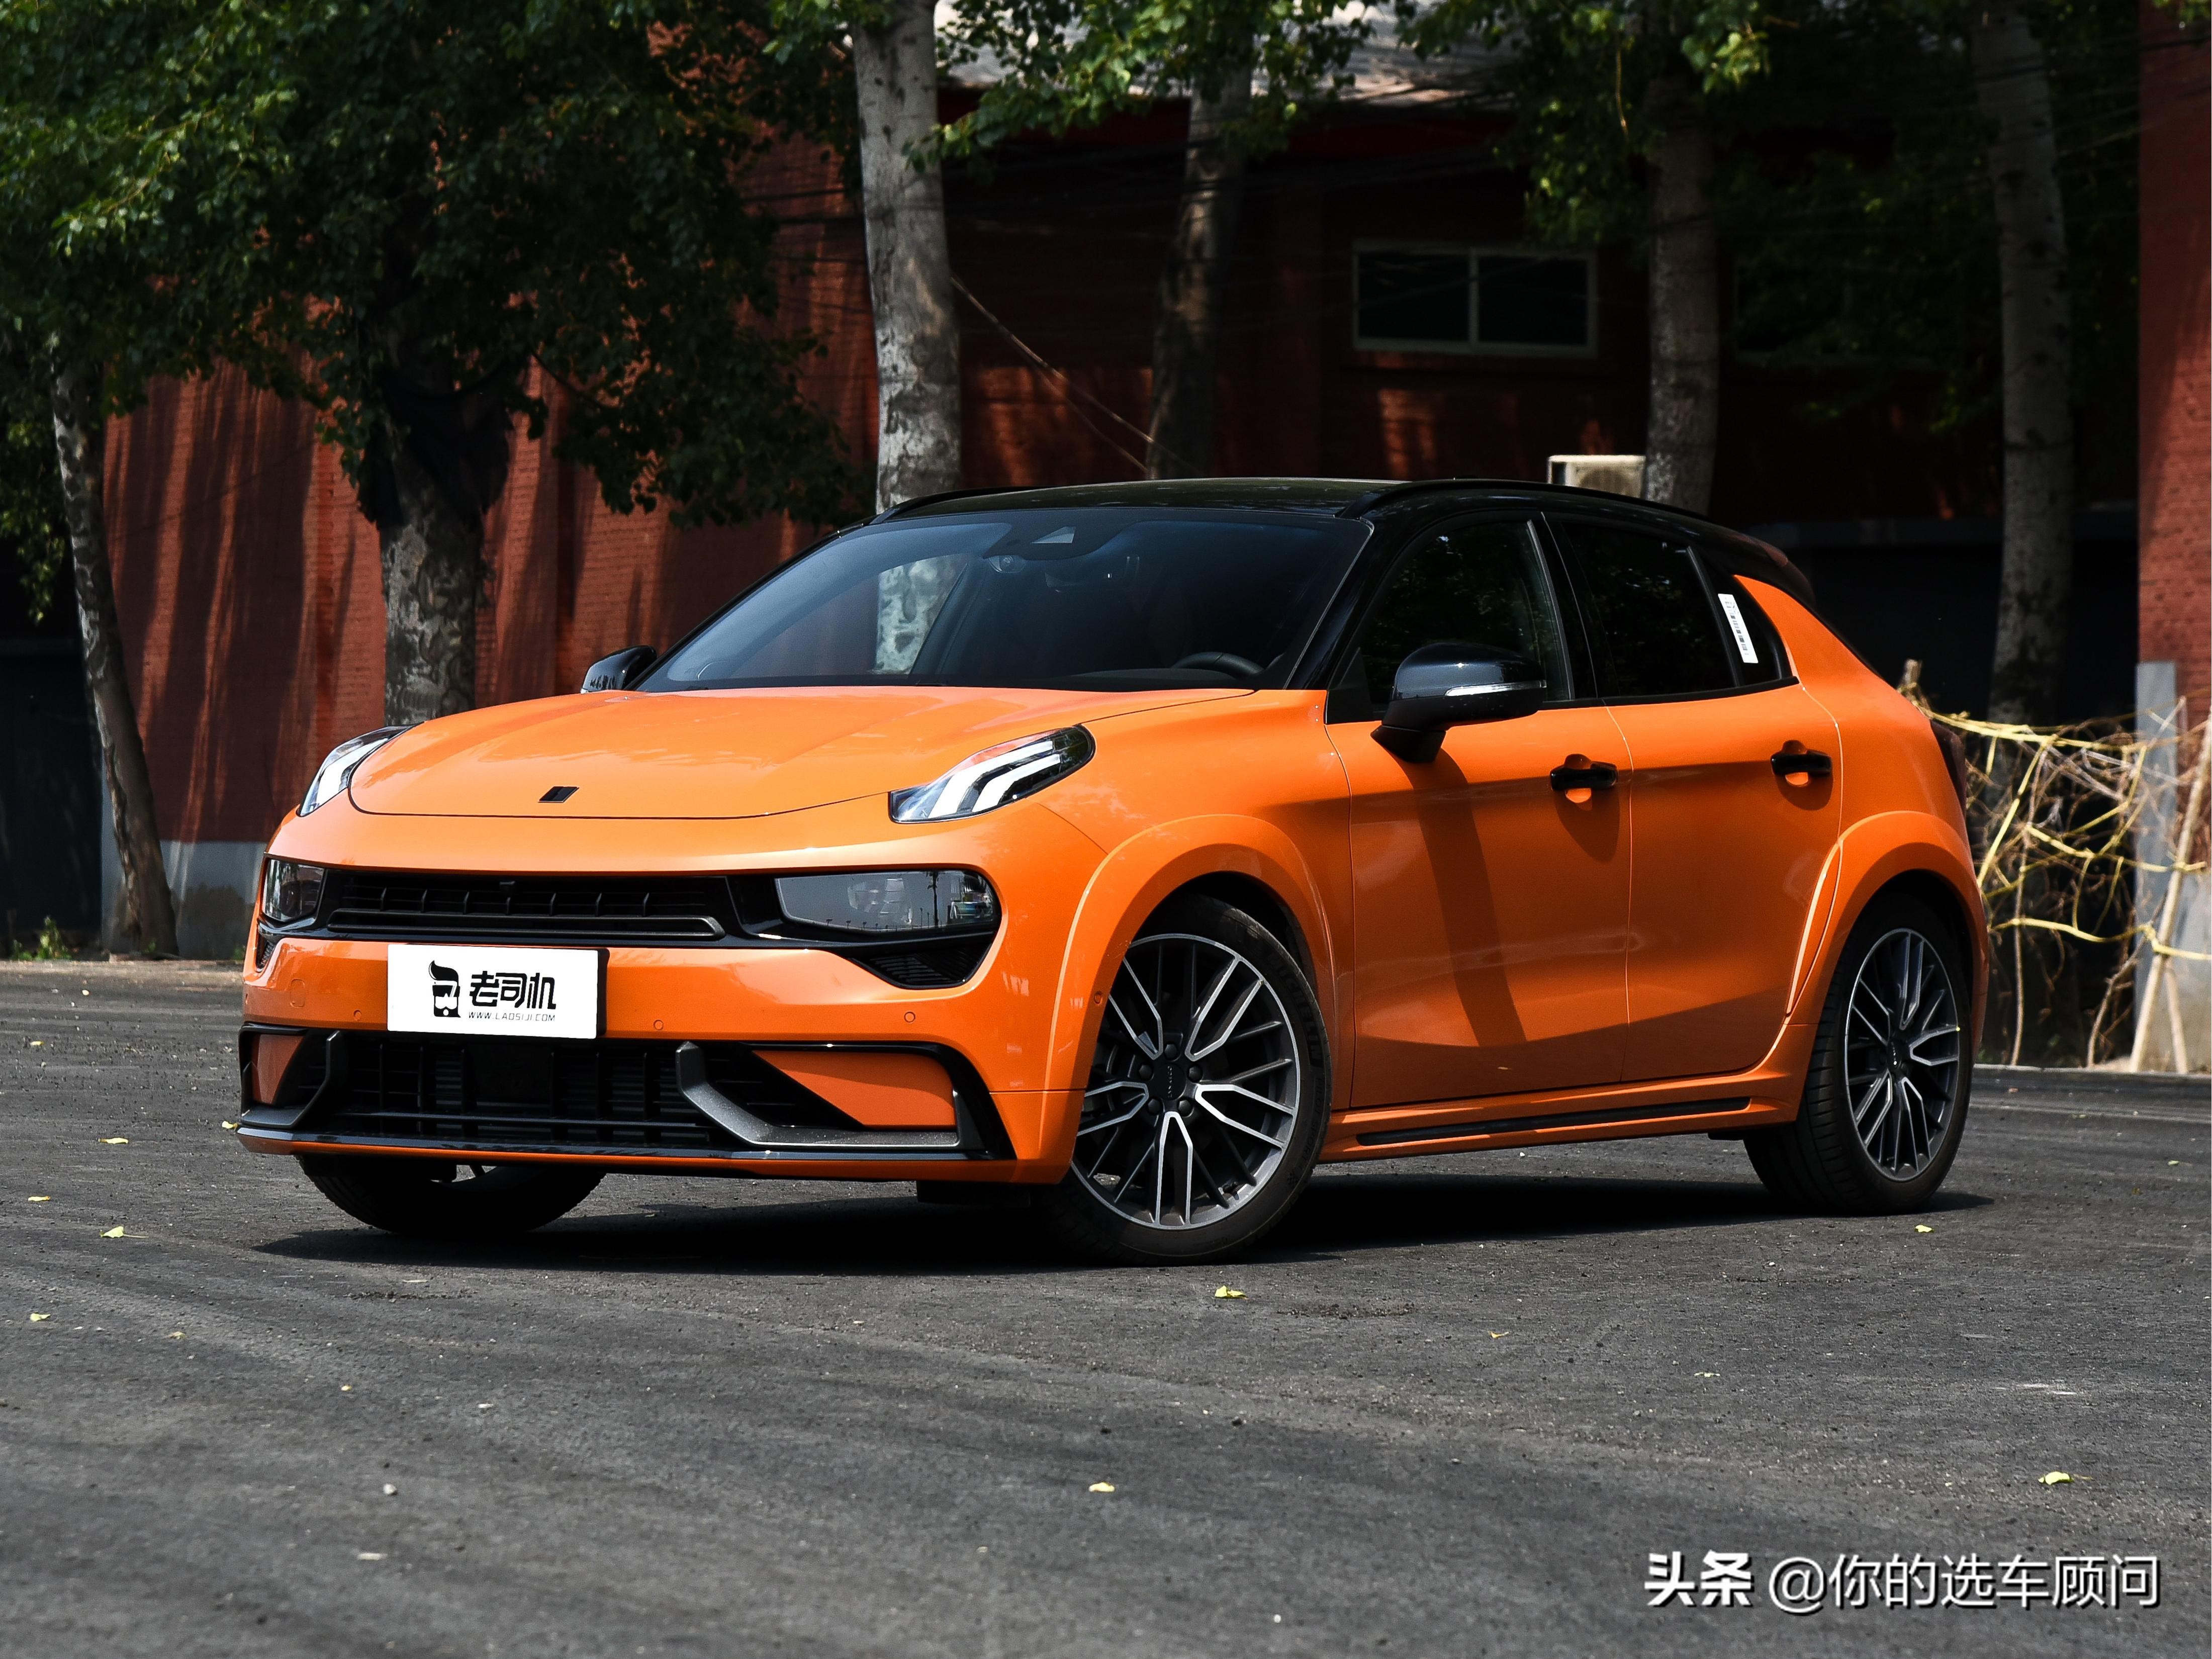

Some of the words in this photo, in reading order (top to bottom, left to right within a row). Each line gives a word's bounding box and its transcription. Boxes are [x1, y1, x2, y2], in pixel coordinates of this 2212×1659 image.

[470, 971, 556, 1009] 老司机
[1267, 952, 1322, 1060] MICHELIN
[469, 1011, 556, 1022] WWW.LAOSIJI.COM
